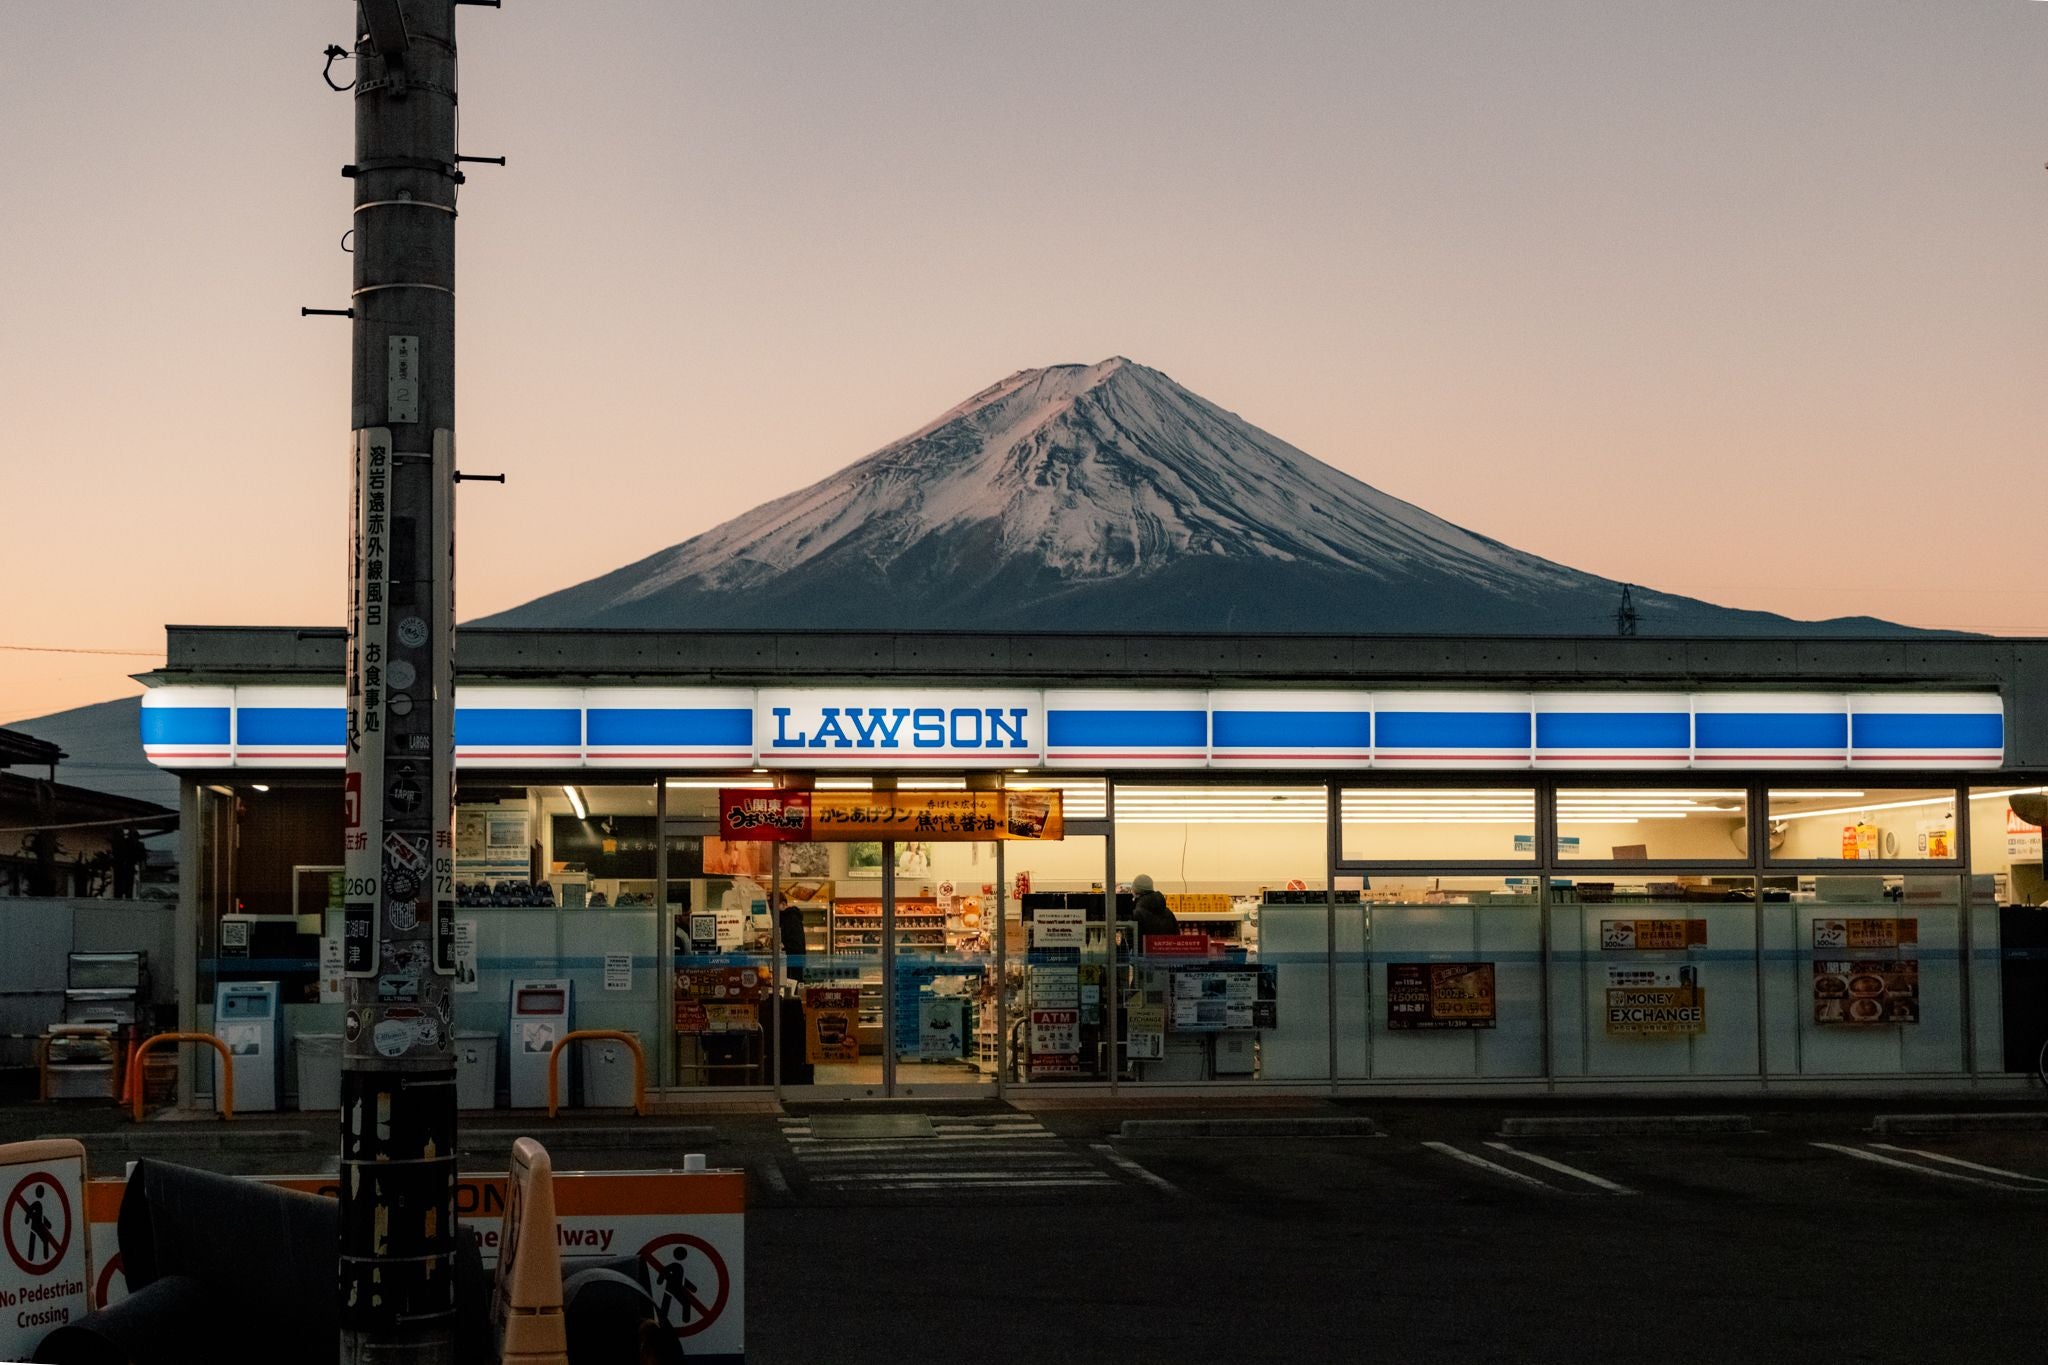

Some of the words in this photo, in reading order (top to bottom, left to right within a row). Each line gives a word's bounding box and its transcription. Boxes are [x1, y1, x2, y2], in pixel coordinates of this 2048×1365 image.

[367, 446, 386, 626] 溶岩遠赤外線風呂
[365, 643, 381, 732] お食事処
[773, 708, 1028, 748] LAWSON
[753, 799, 783, 812] 関東
[820, 806, 912, 824] からあげクン
[1626, 994, 1674, 1004] MONEY
[1041, 1013, 1070, 1023] ATM
[1610, 1009, 1700, 1021] EXCHANGE
[19, 1279, 84, 1304] Pedestrian
[17, 1307, 69, 1329] Crossing
